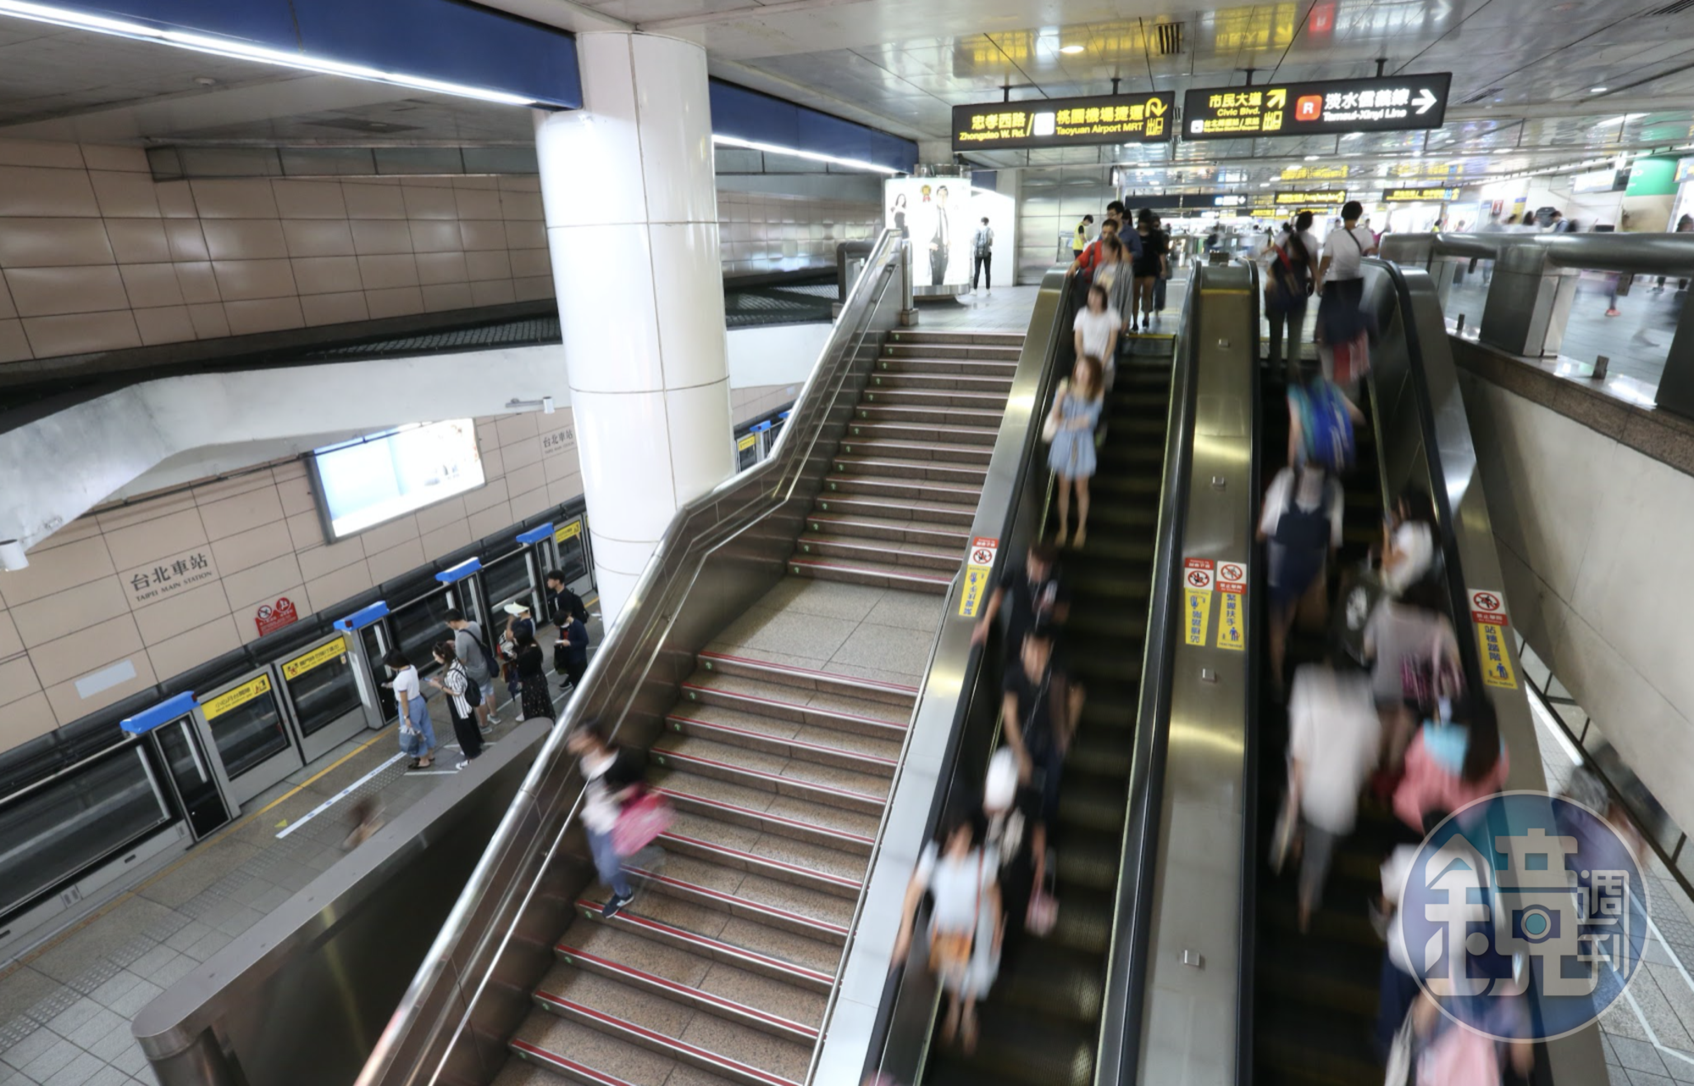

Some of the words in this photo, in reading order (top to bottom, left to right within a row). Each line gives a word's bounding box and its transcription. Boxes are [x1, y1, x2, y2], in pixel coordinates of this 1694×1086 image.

[1209, 91, 1262, 108] 市民大道
[1302, 102, 1314, 114] R
[1324, 88, 1410, 110] 淡水信義線
[971, 112, 1026, 130] 忠孝西路
[1057, 105, 1144, 125] 桃園機場捷運
[1217, 108, 1238, 117] Civic
[1240, 107, 1261, 116] Blvd.
[1262, 110, 1283, 131] 出口
[1385, 108, 1407, 119] Line
[959, 131, 1000, 141] Zhongxiao
[1000, 129, 1011, 138] W.
[1011, 128, 1026, 138] Rd.
[1056, 126, 1090, 136] Taoyuan
[1091, 124, 1121, 135] Airport
[1123, 122, 1144, 132] MRT
[1146, 117, 1164, 136] 出口
[130, 553, 208, 591] 台北車站
[136, 589, 159, 602] TAIPEI
[161, 582, 182, 593] MAIN
[183, 571, 213, 586] STATION
[1226, 594, 1236, 626] 緊握扶手
